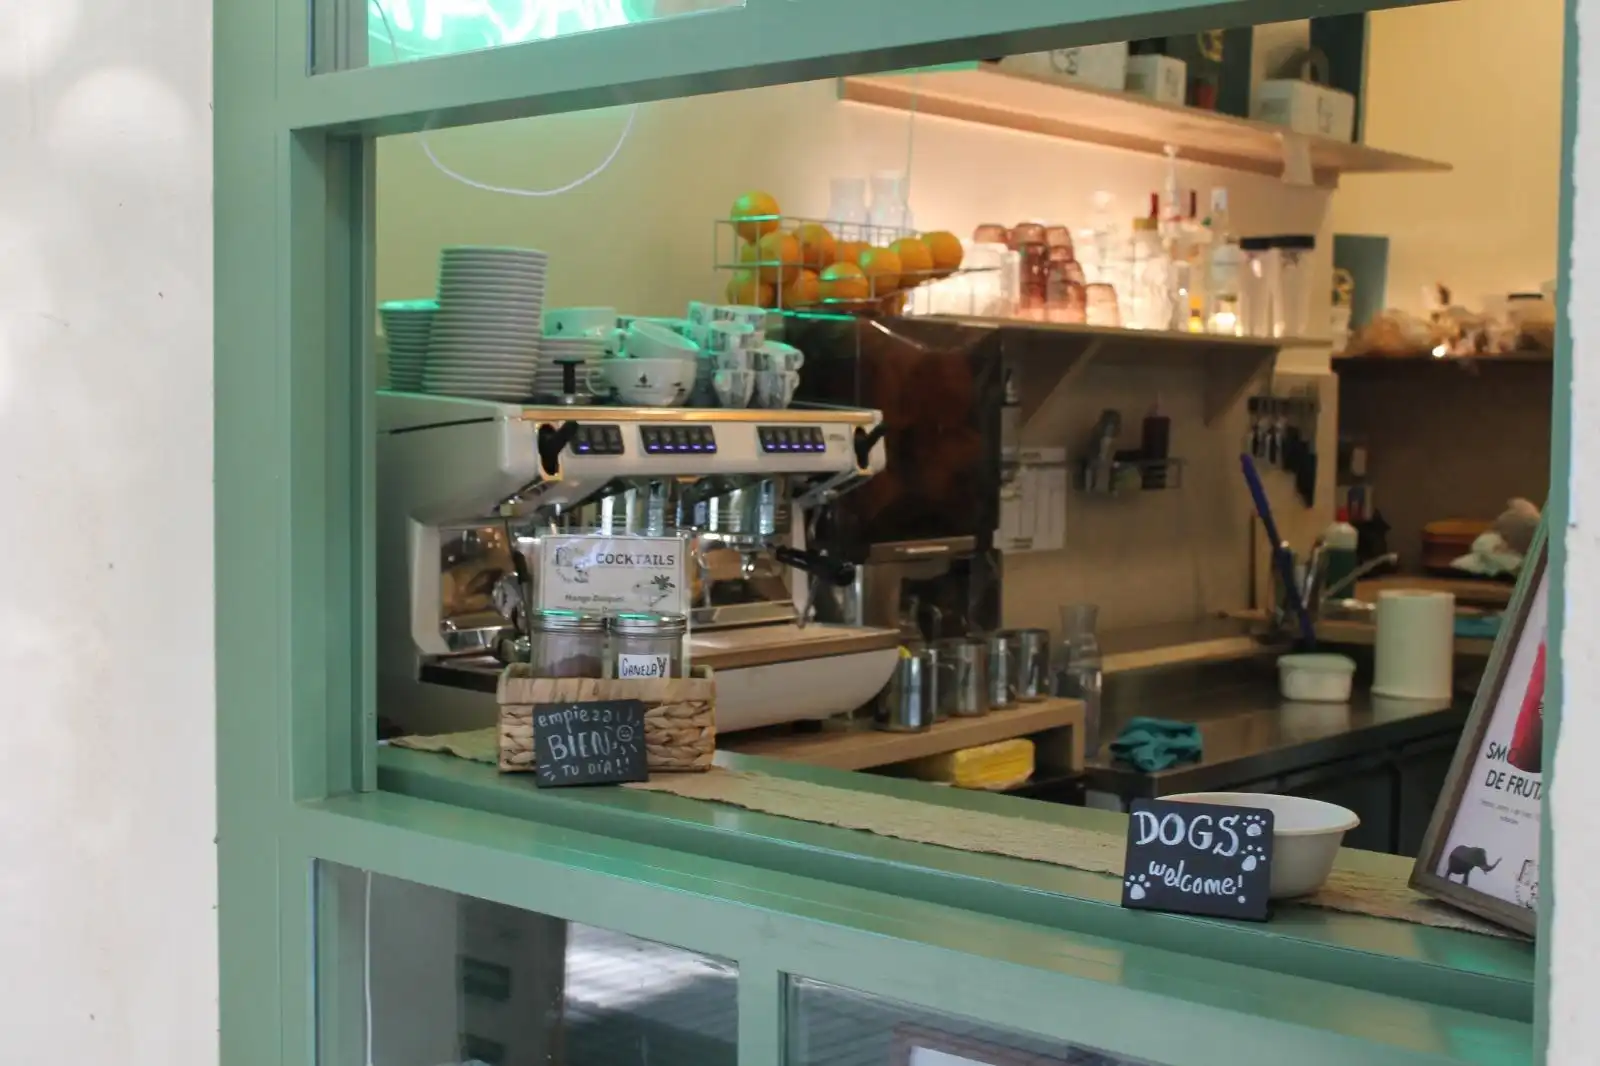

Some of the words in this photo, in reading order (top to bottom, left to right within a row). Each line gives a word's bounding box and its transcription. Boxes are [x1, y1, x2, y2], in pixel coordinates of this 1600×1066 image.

[596, 552, 675, 567] COCKTAILS
[547, 728, 610, 761] BIEN
[561, 764, 579, 776] TU
[1485, 769, 1506, 790] DE
[1506, 774, 1542, 801] FRUT
[1132, 810, 1240, 857] DOGS
[1148, 859, 1246, 905] welcome!
